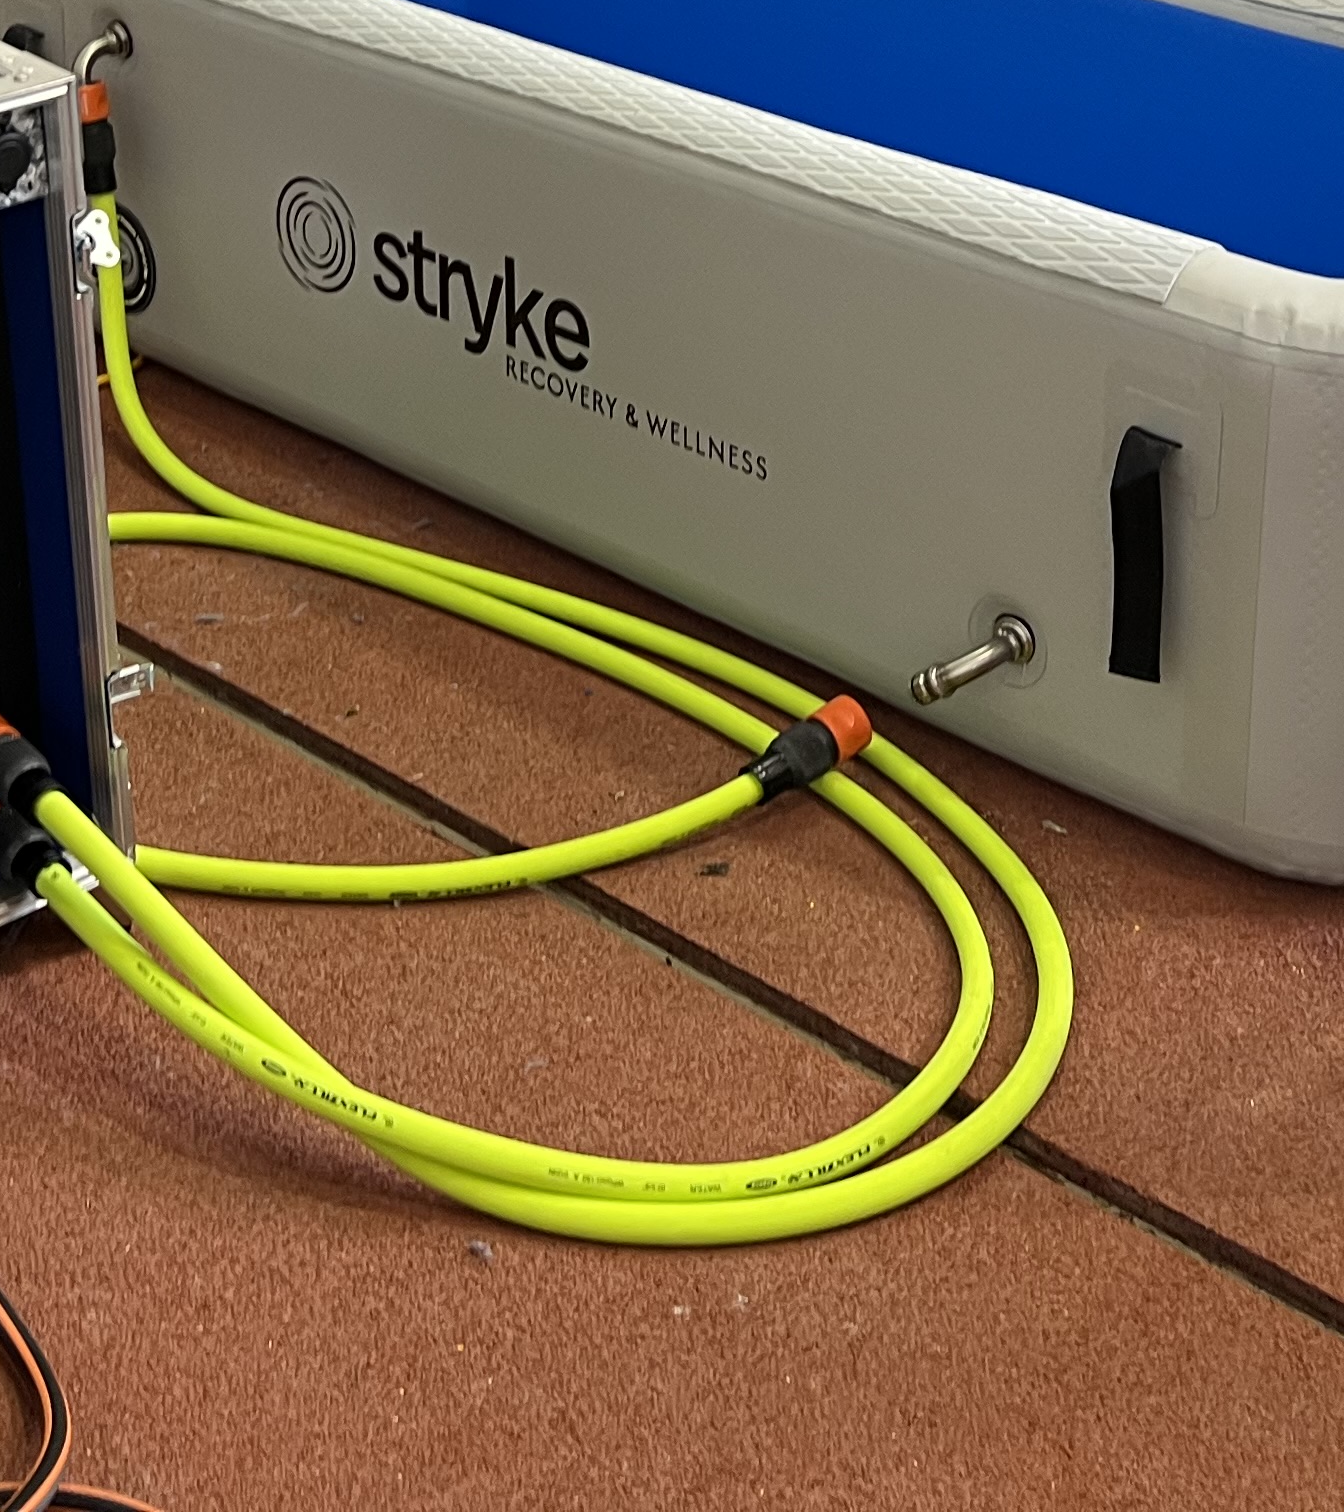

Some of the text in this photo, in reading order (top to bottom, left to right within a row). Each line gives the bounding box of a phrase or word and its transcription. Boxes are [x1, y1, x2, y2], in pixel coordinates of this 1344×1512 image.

[373, 230, 590, 372] stryke
[505, 354, 768, 481] RECOVERY & WELLNESS
